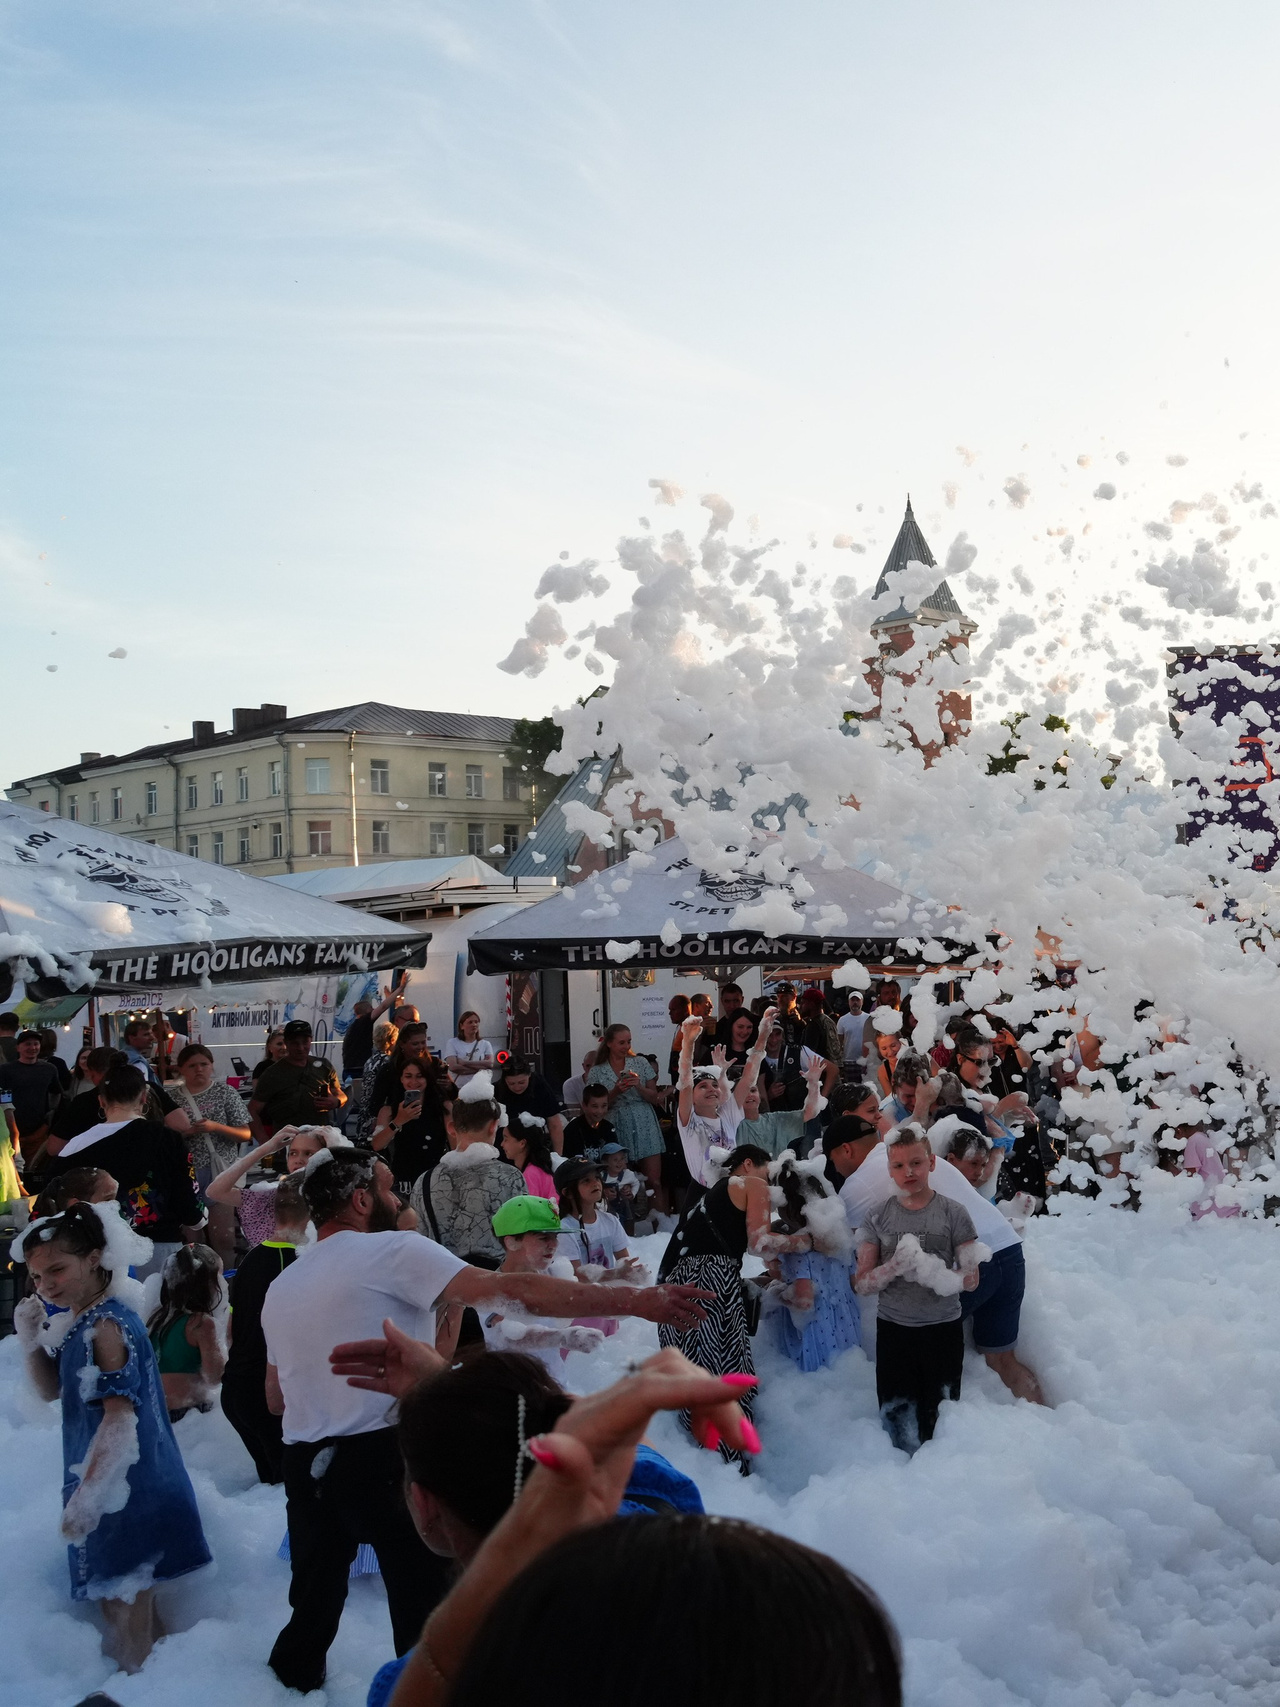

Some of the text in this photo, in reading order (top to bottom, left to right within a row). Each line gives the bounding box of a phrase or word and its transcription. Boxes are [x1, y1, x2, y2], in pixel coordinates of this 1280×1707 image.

[638, 937, 808, 960] HOOLIGANS
[107, 942, 386, 984] THE HOOLIGANS FAMILY
[211, 1006, 251, 1028] АКТИВНОЙ
